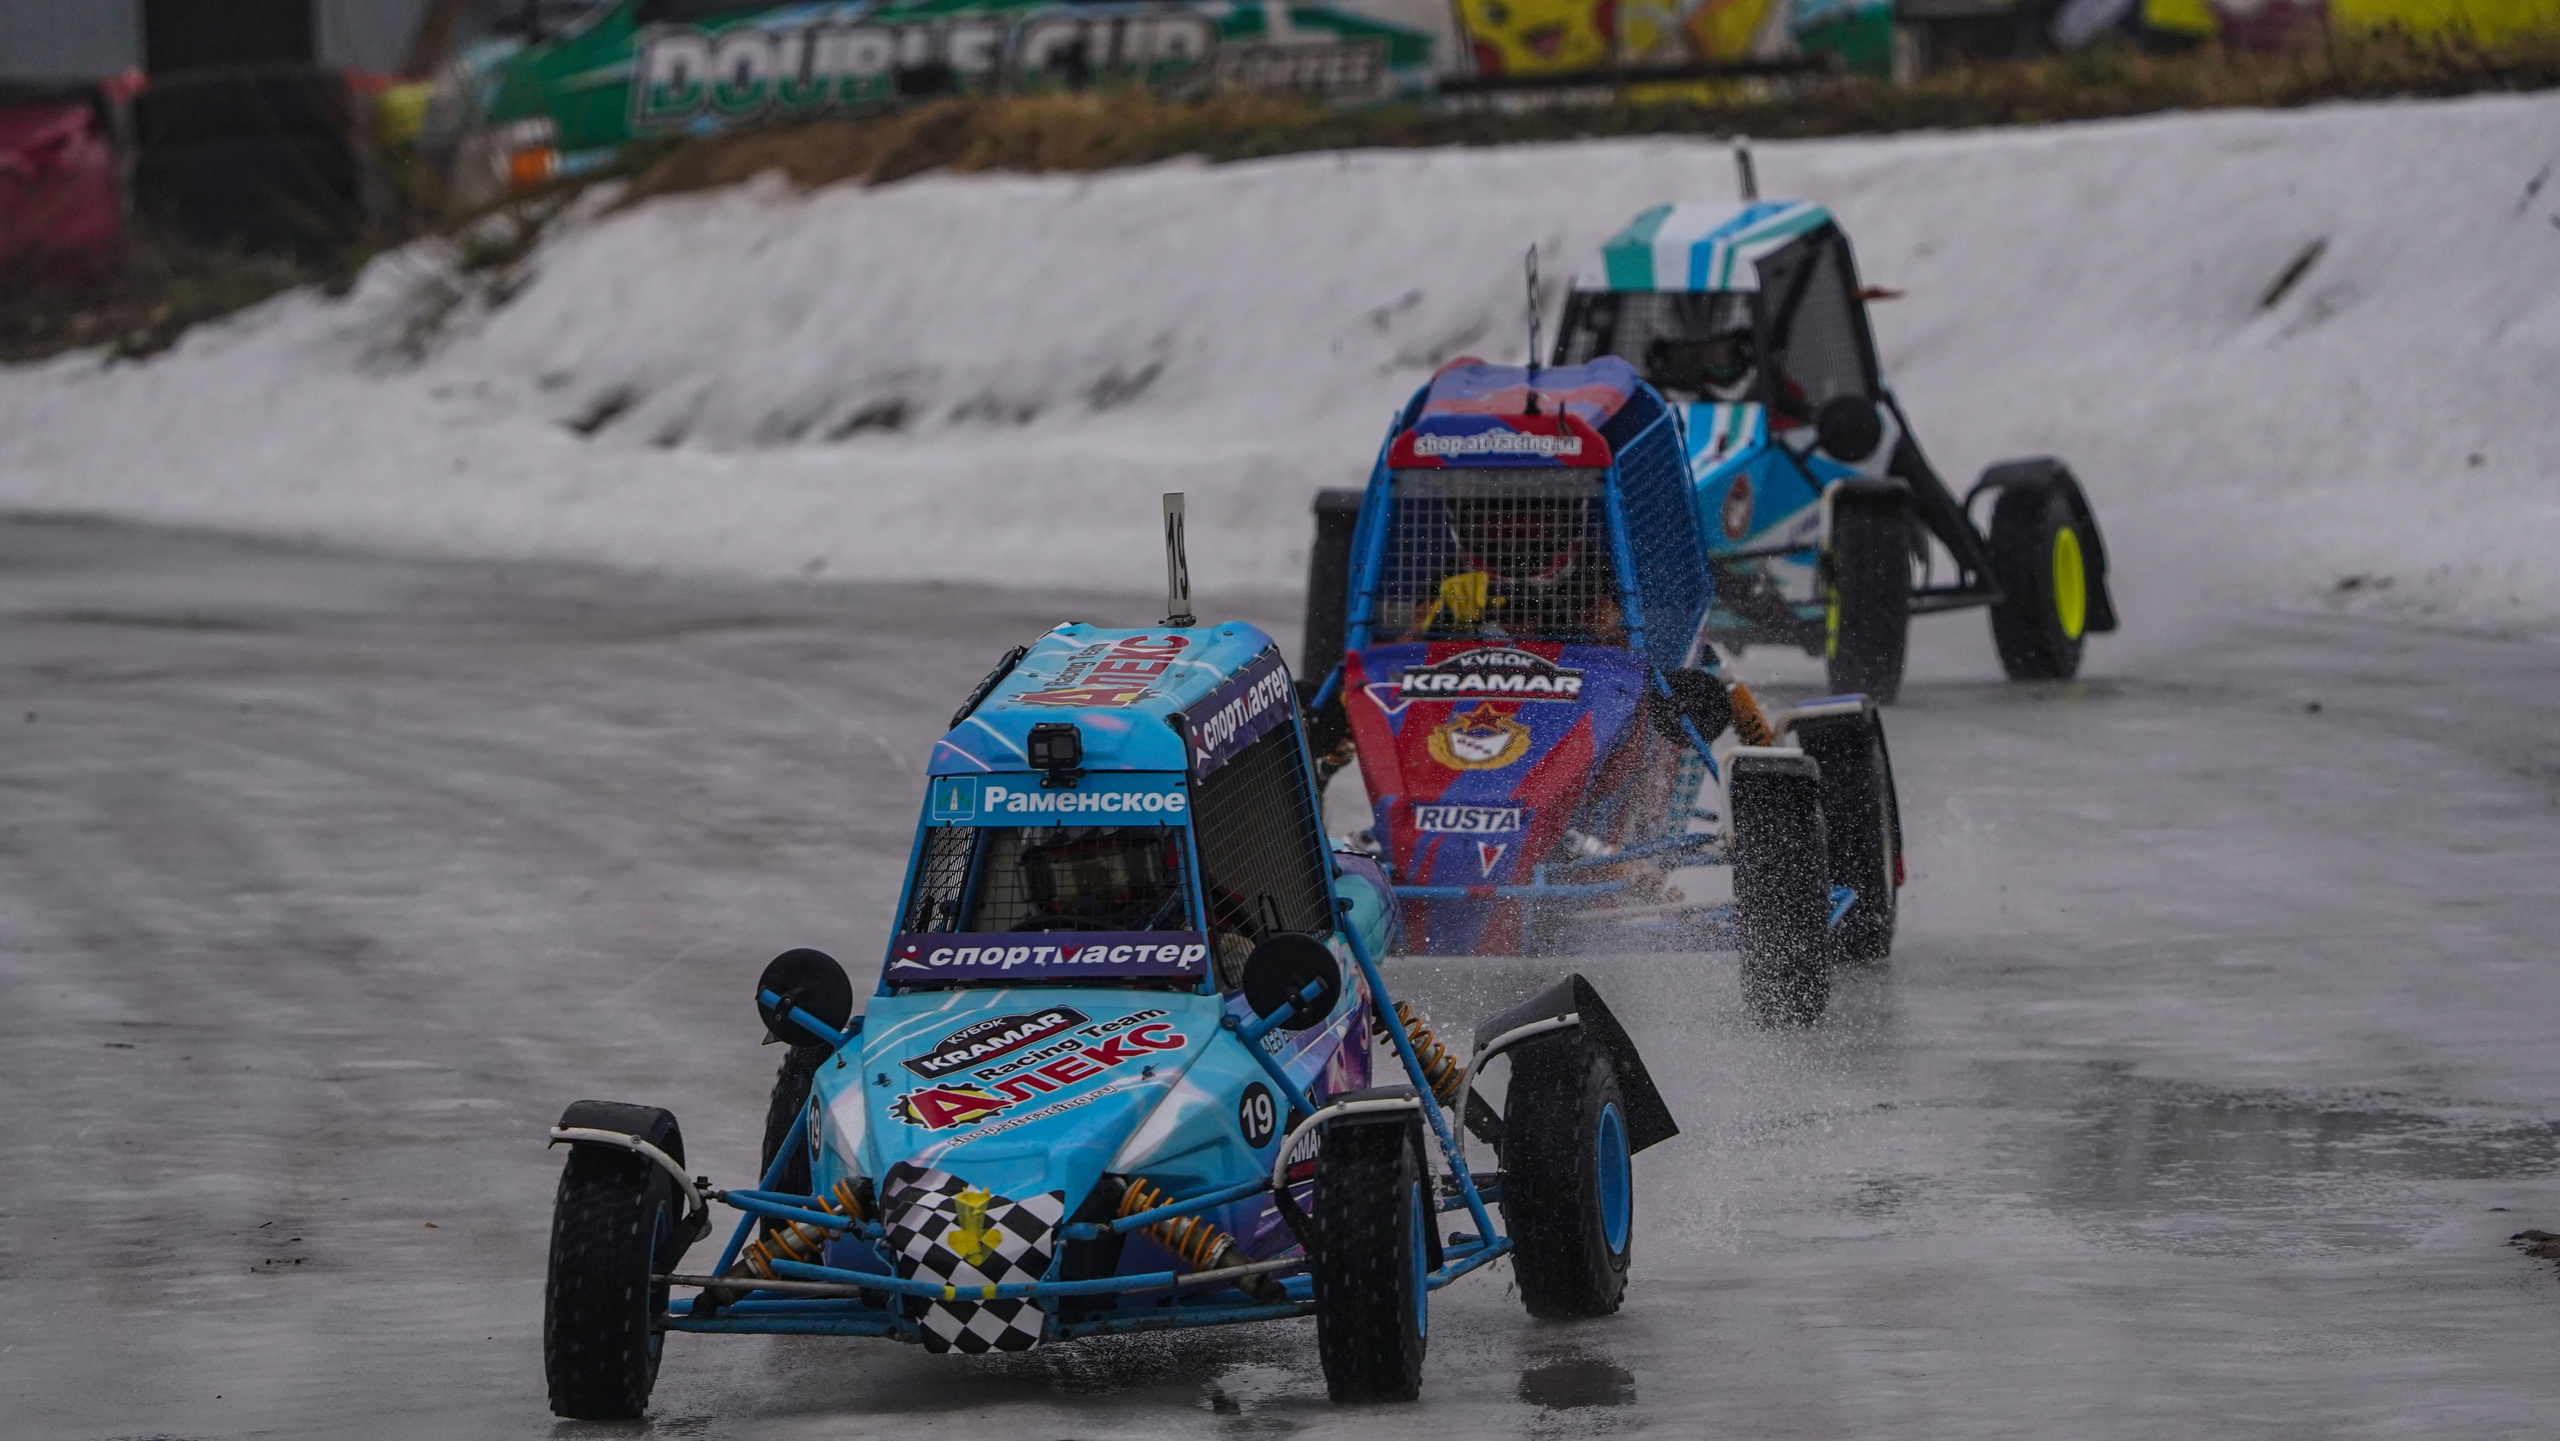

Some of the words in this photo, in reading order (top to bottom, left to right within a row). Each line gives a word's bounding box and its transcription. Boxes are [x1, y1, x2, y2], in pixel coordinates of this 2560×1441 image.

[1459, 651, 1536, 669] КУБОК
[1401, 672, 1583, 695] KRAMAR
[1202, 664, 1290, 752] спортмастер
[983, 785, 1187, 813] Раменское
[1419, 808, 1516, 830] RUSTA
[928, 942, 1207, 970] спортмастер
[920, 1011, 1068, 1072] KRAMAR
[946, 1017, 1007, 1044] КУБОК
[972, 1037, 1084, 1081] Racing
[1076, 1008, 1168, 1038] Team
[908, 1023, 1188, 1130] АЛЕКС
[810, 1105, 820, 1150] 19
[1241, 1093, 1274, 1140] 19
